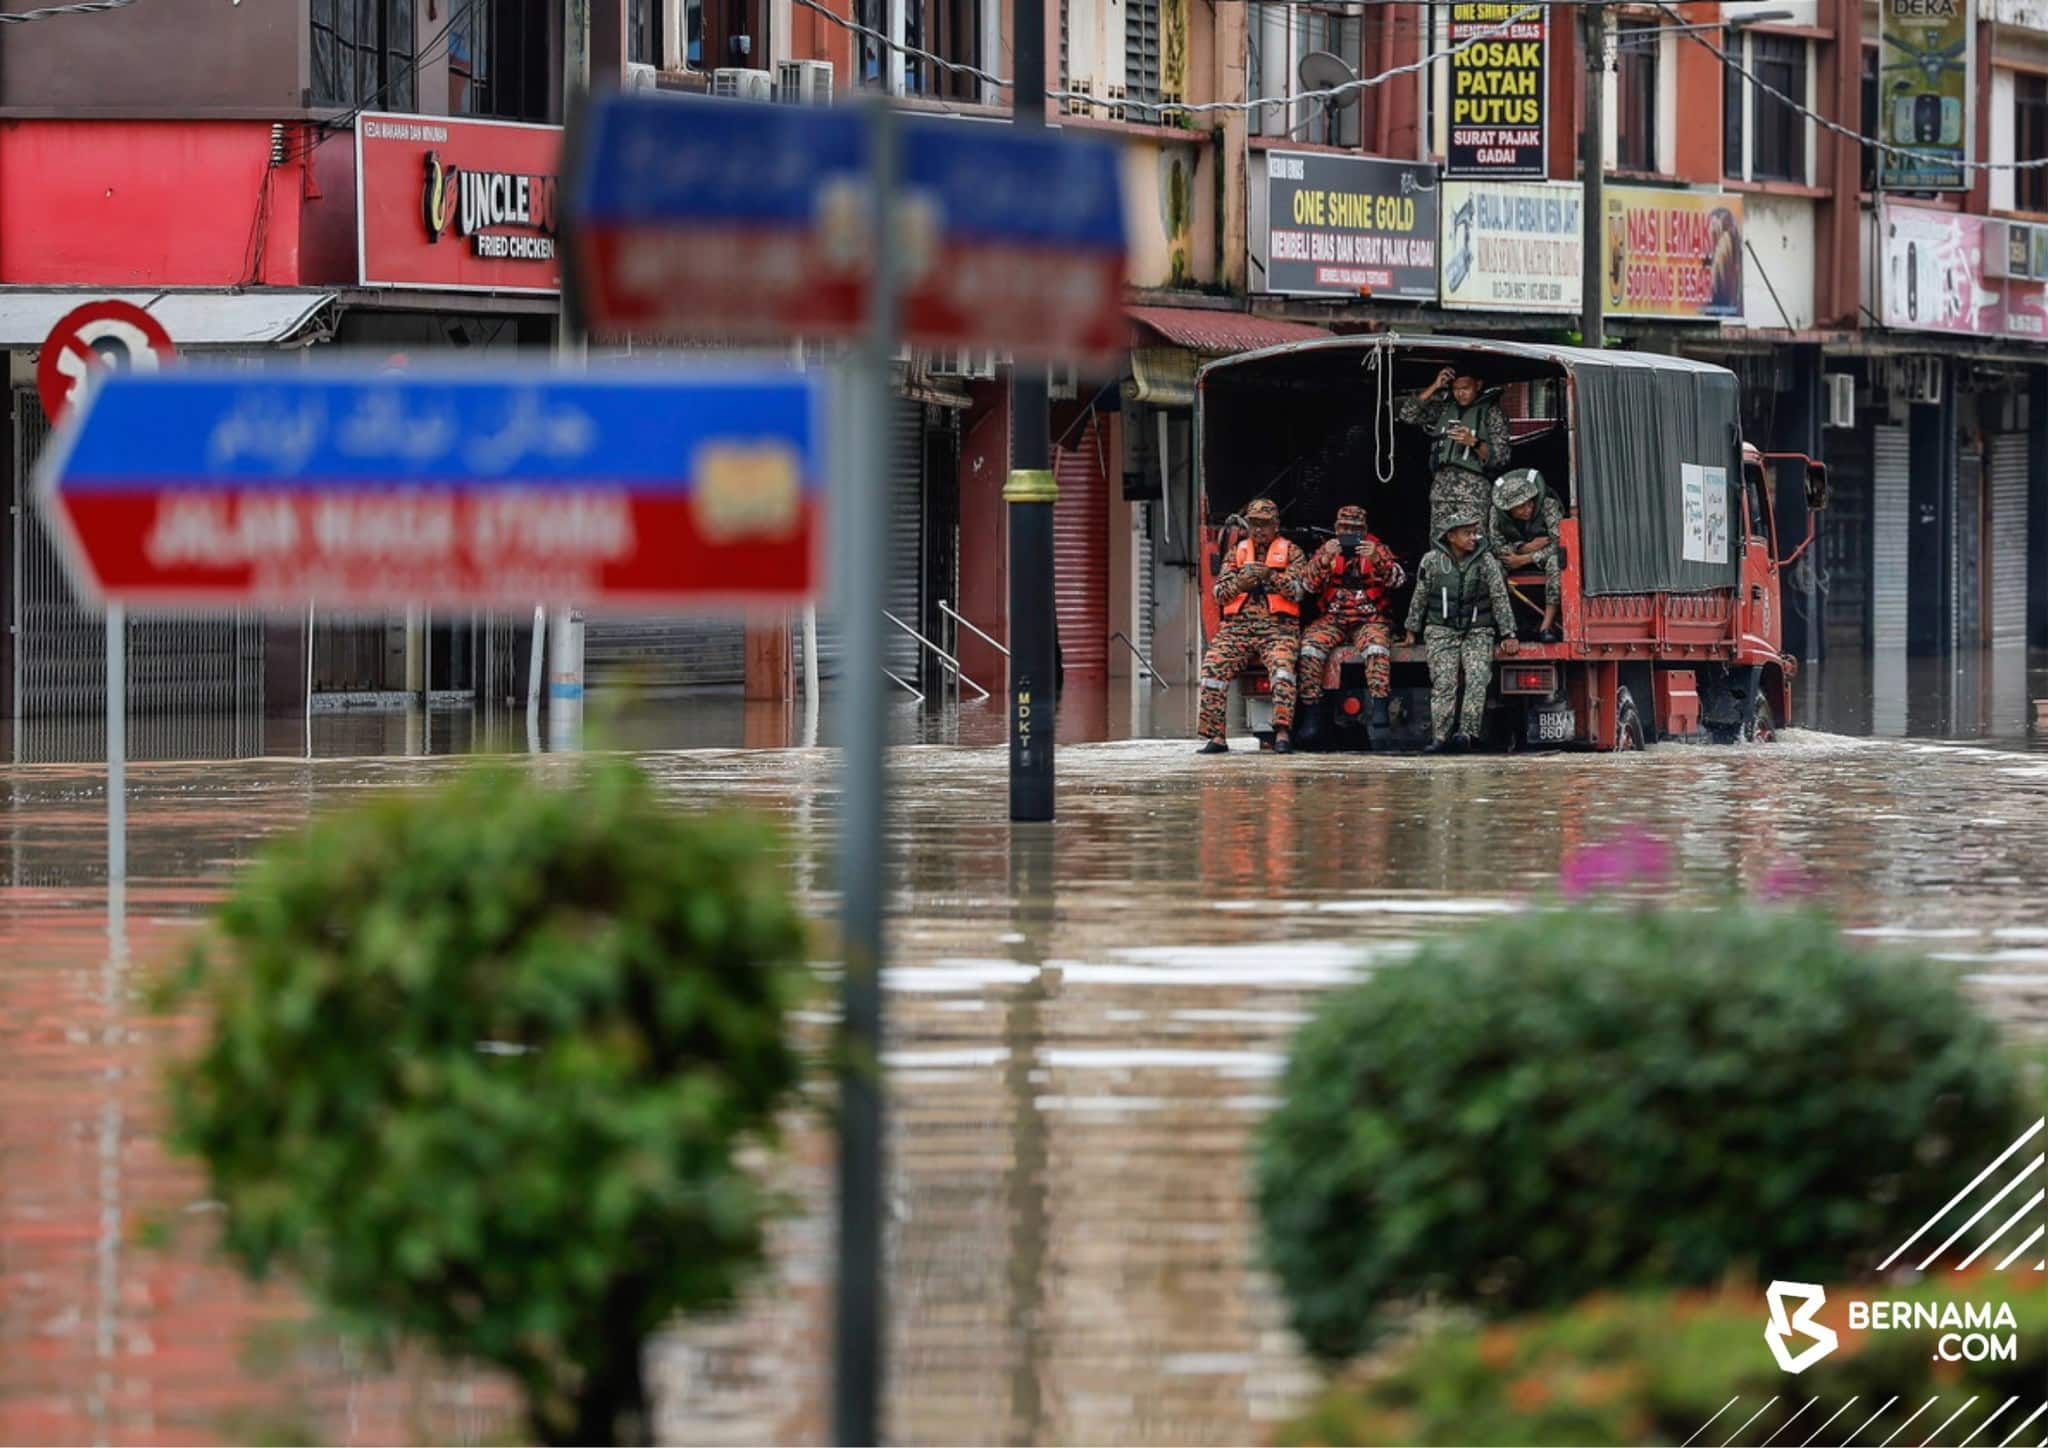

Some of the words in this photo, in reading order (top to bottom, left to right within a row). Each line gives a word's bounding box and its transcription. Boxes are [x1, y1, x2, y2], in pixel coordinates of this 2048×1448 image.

[1454, 4, 1475, 20] ONE
[1477, 4, 1509, 20] SHINE
[1894, 0, 1955, 16] DEKA
[1511, 24, 1540, 39] EMAS
[1454, 42, 1540, 67] ROSAK
[1457, 71, 1536, 95] PATAH
[1454, 98, 1538, 123] PUTUS
[1454, 130, 1496, 145] SURAT
[1498, 130, 1540, 145] PAJAK
[1477, 148, 1516, 163] GADAI
[1294, 189, 1325, 225] ONE
[1328, 191, 1372, 229] SHINE
[1375, 195, 1414, 231] GOLD
[1627, 208, 1660, 256] NASI
[1664, 208, 1713, 259] LEMAK
[478, 234, 508, 257] FRIED
[509, 236, 555, 259] CHICKEN
[1311, 233, 1335, 262] EMAS
[1336, 234, 1354, 262] DAN
[1354, 236, 1381, 264] SURAT
[1382, 238, 1409, 266] PAJAK
[1409, 239, 1435, 267] GADAI
[1627, 264, 1673, 301] SOTONG
[1677, 266, 1713, 303] BESAR
[1018, 692, 1030, 747] MDKT
